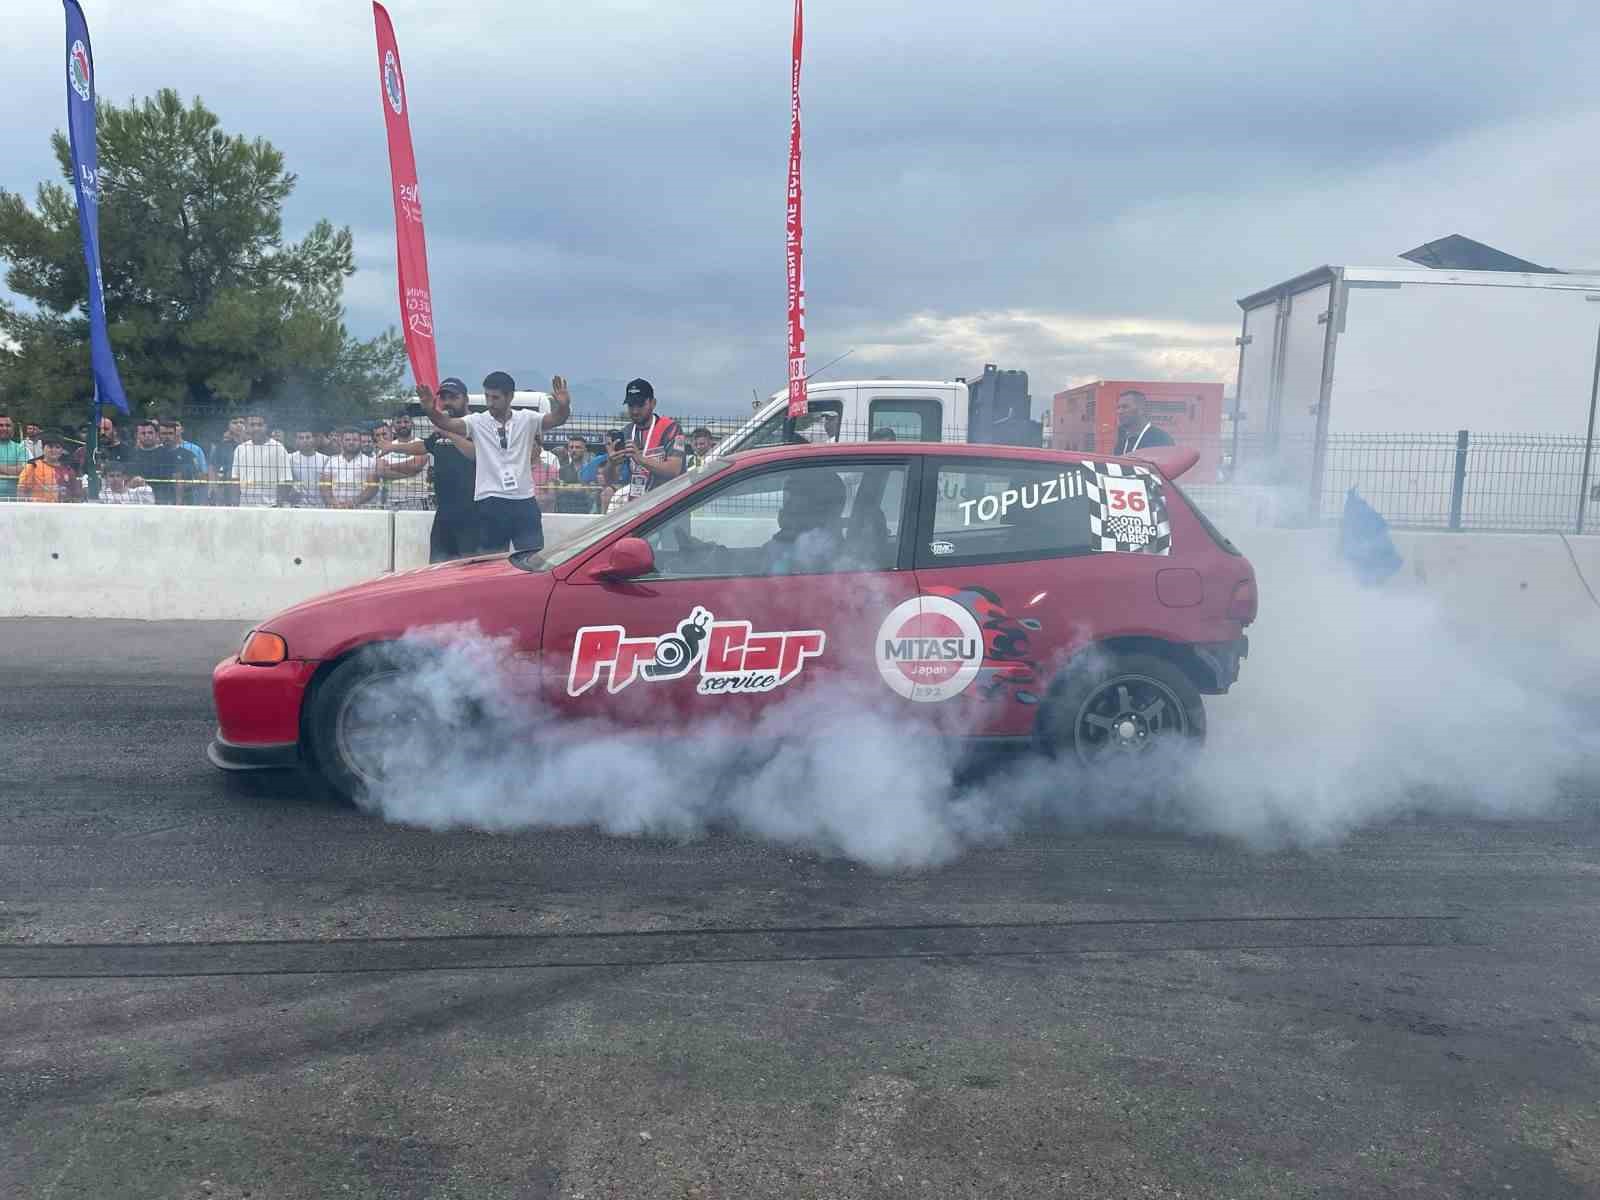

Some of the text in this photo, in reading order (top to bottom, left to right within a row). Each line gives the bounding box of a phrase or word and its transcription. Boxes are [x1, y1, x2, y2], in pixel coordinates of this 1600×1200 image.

[1109, 490, 1146, 512] 36
[1120, 516, 1142, 526] OTO
[1127, 525, 1157, 536] DRAG
[885, 639, 976, 660] MITASU
[911, 663, 947, 677] Japan
[700, 671, 776, 692] service
